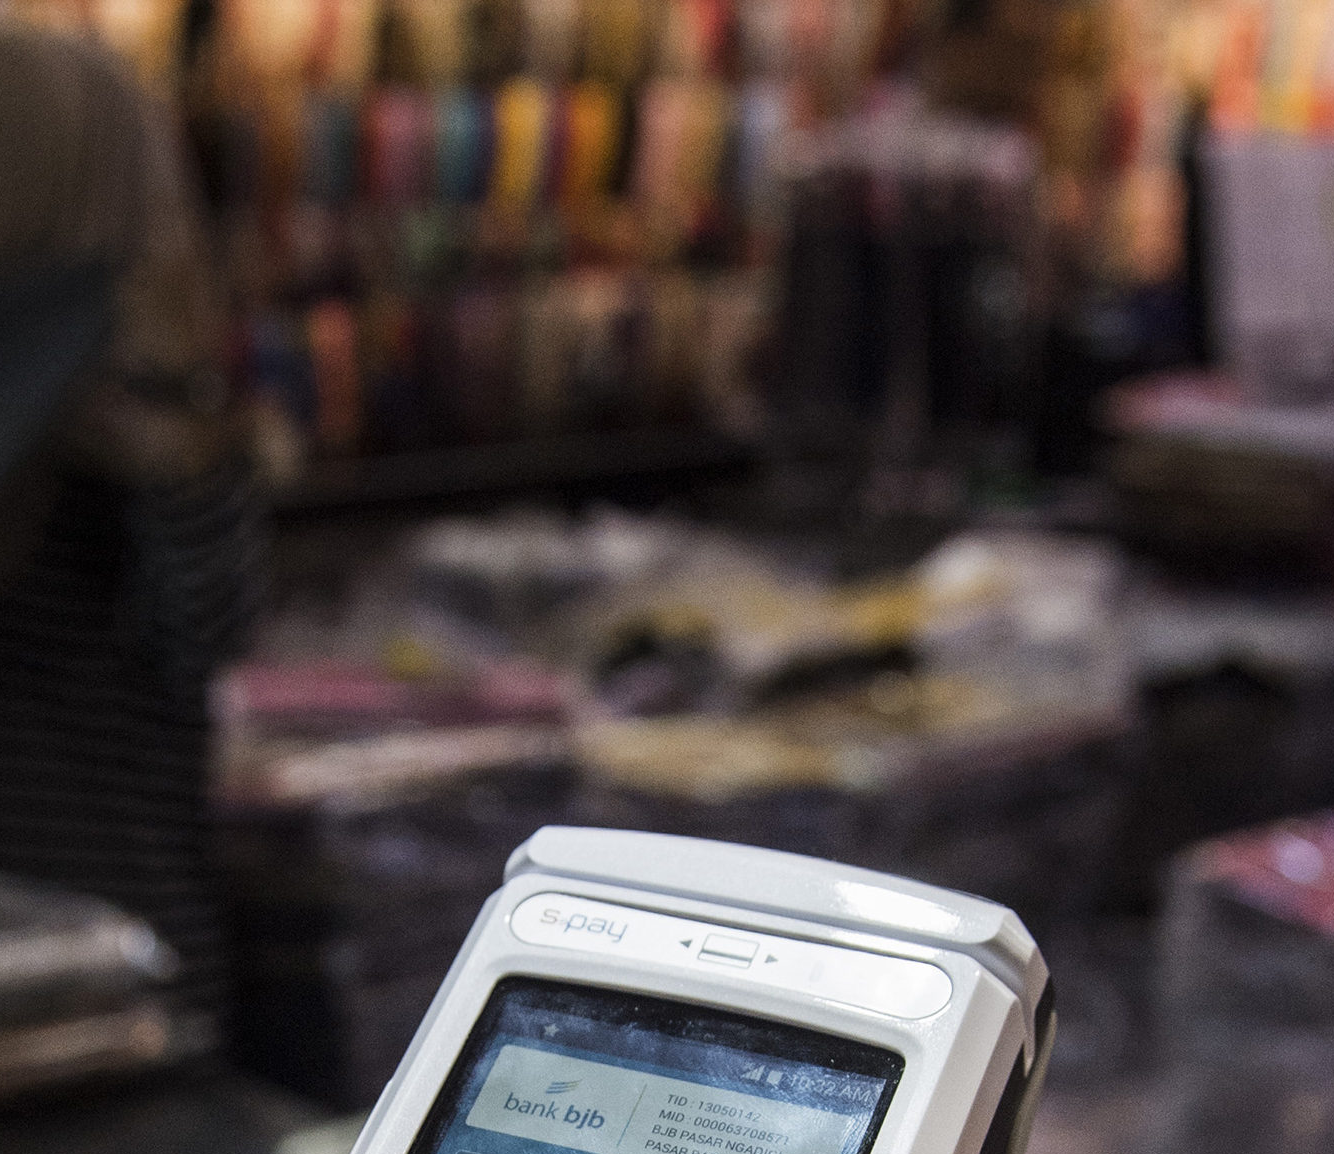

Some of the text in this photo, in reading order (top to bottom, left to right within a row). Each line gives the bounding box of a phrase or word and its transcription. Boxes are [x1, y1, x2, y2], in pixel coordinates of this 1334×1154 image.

[838, 1085, 871, 1102] AM
[504, 1092, 606, 1130] bank bjb
[658, 1109, 685, 1123] MID
[667, 1094, 688, 1107] TID
[698, 1101, 762, 1122] 13050142
[651, 1124, 678, 1139] BJB
[679, 1130, 724, 1149] PASAR
